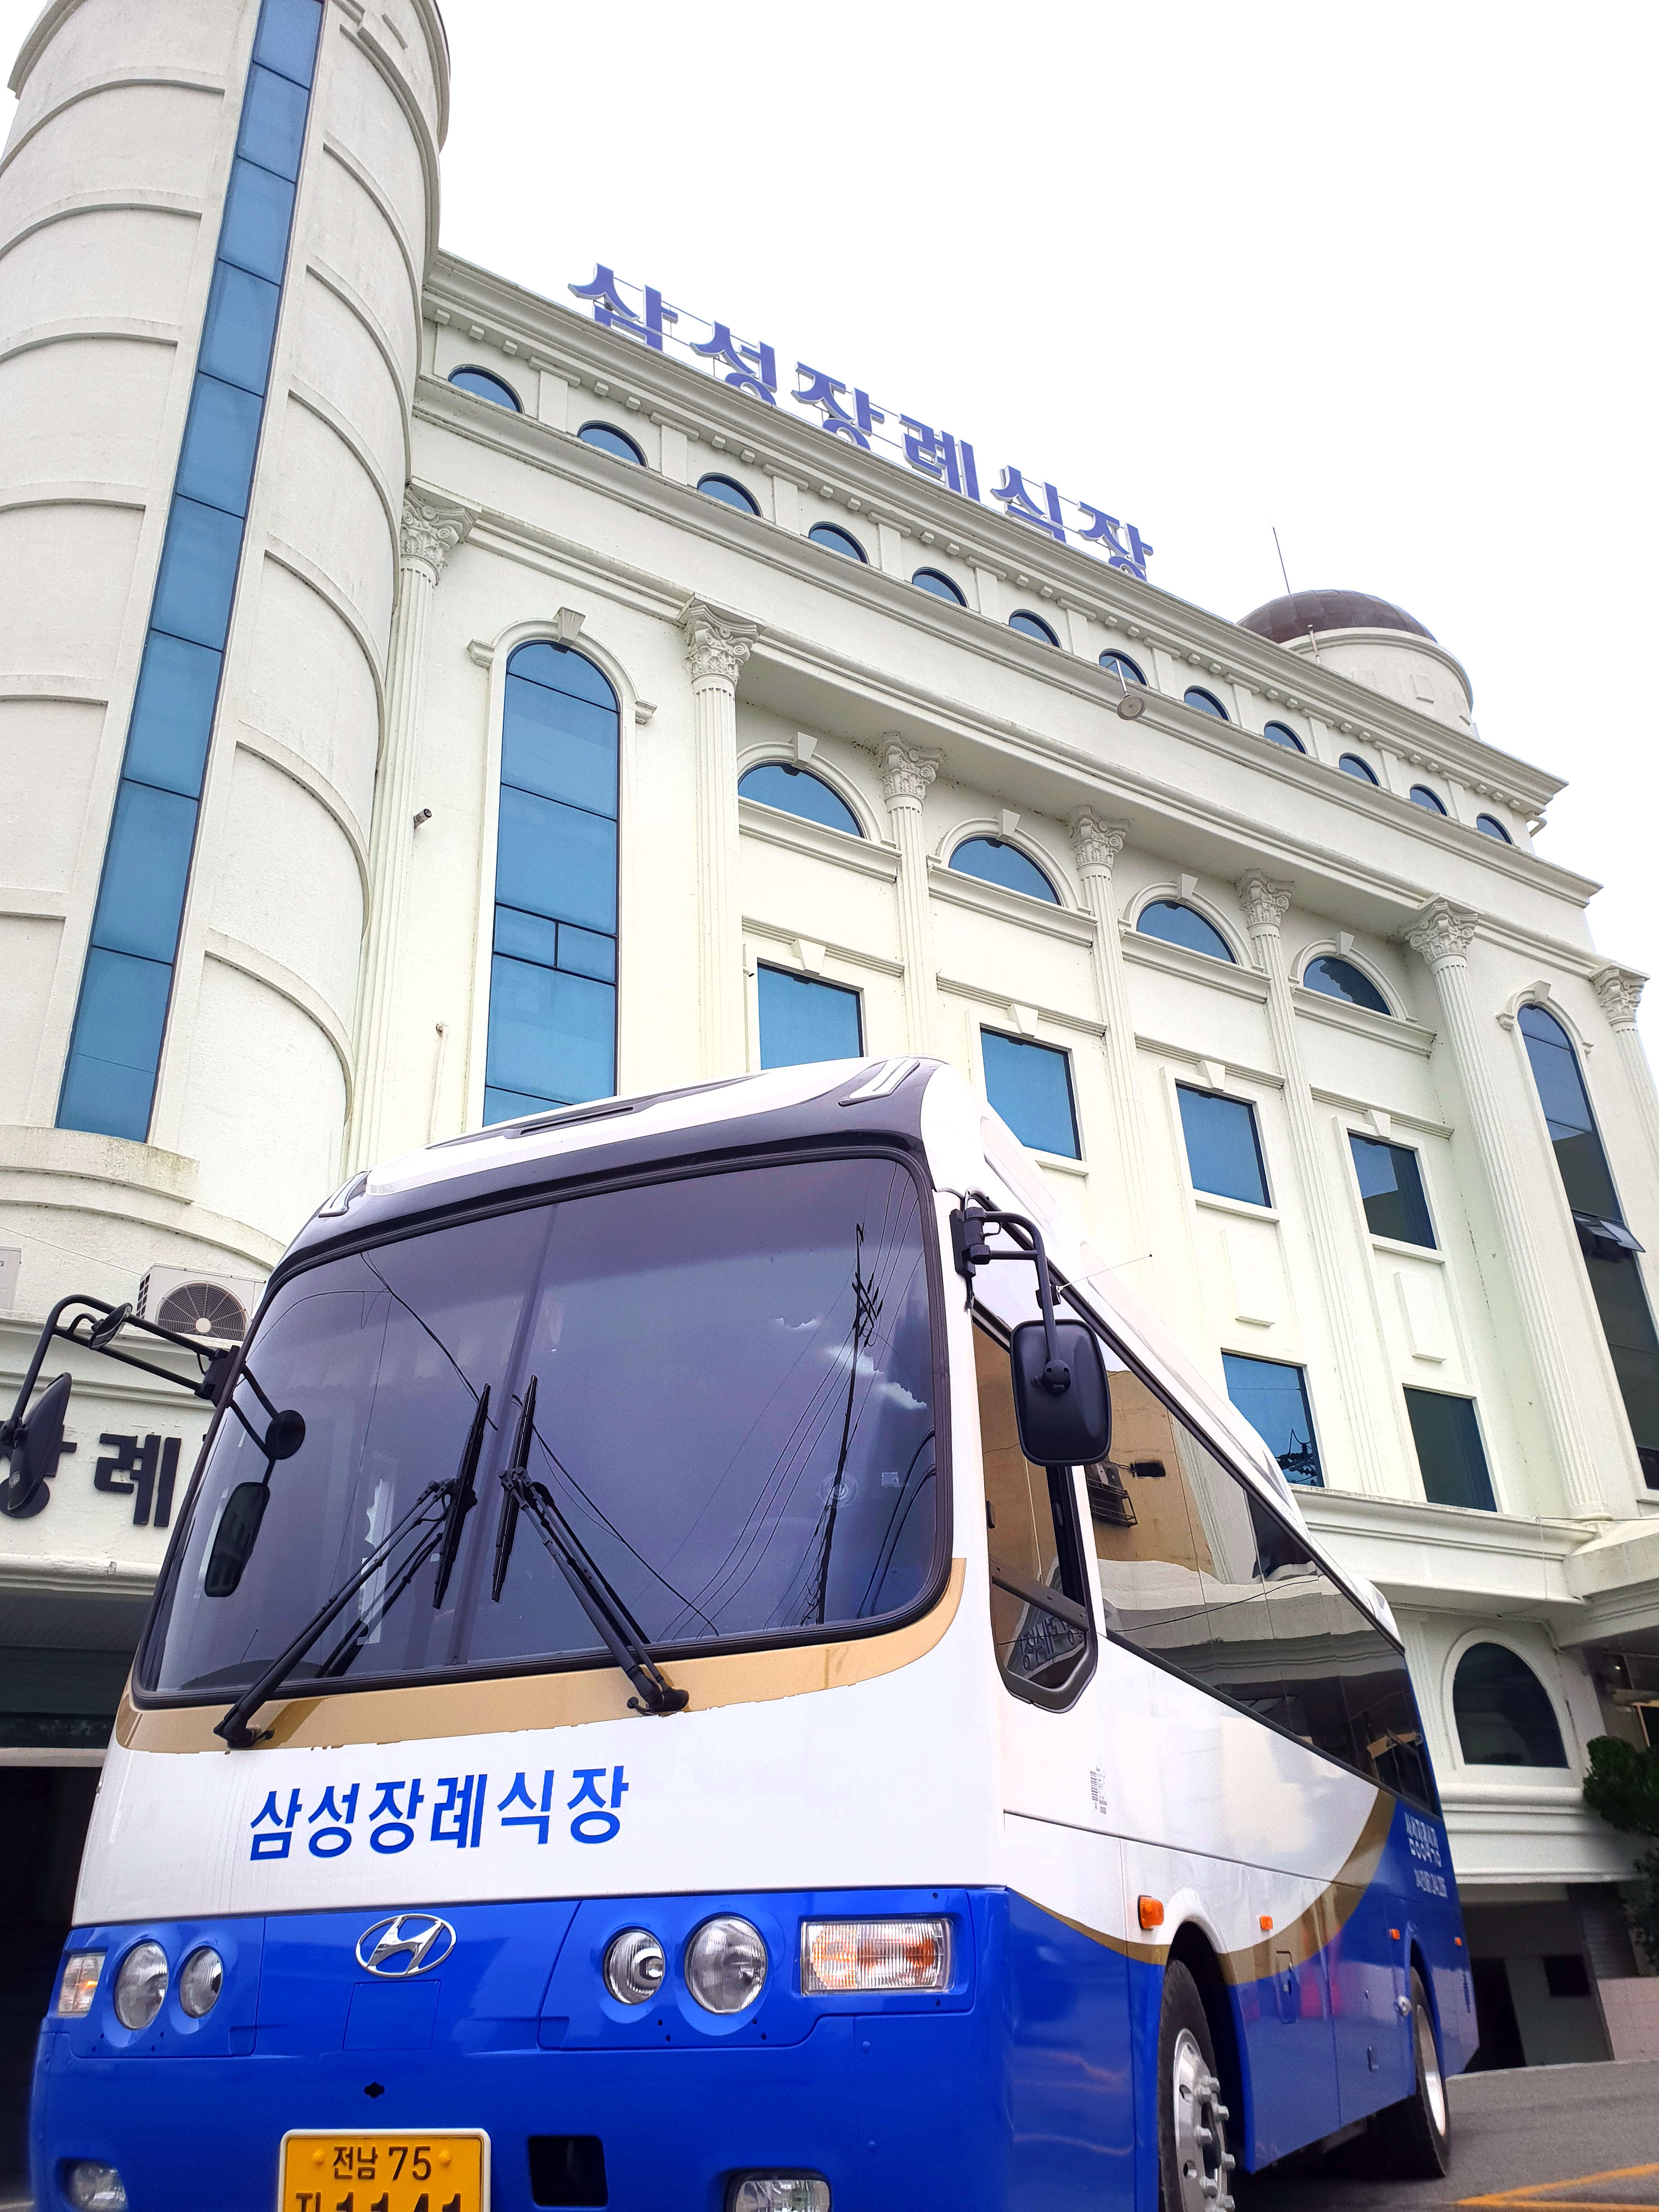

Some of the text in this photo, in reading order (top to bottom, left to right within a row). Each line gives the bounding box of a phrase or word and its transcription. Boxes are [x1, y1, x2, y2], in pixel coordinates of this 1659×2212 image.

[567, 263, 1154, 582] 삼성장례식장
[250, 1765, 629, 1861] 삼성장례식장
[333, 2146, 432, 2181] 전남 75
